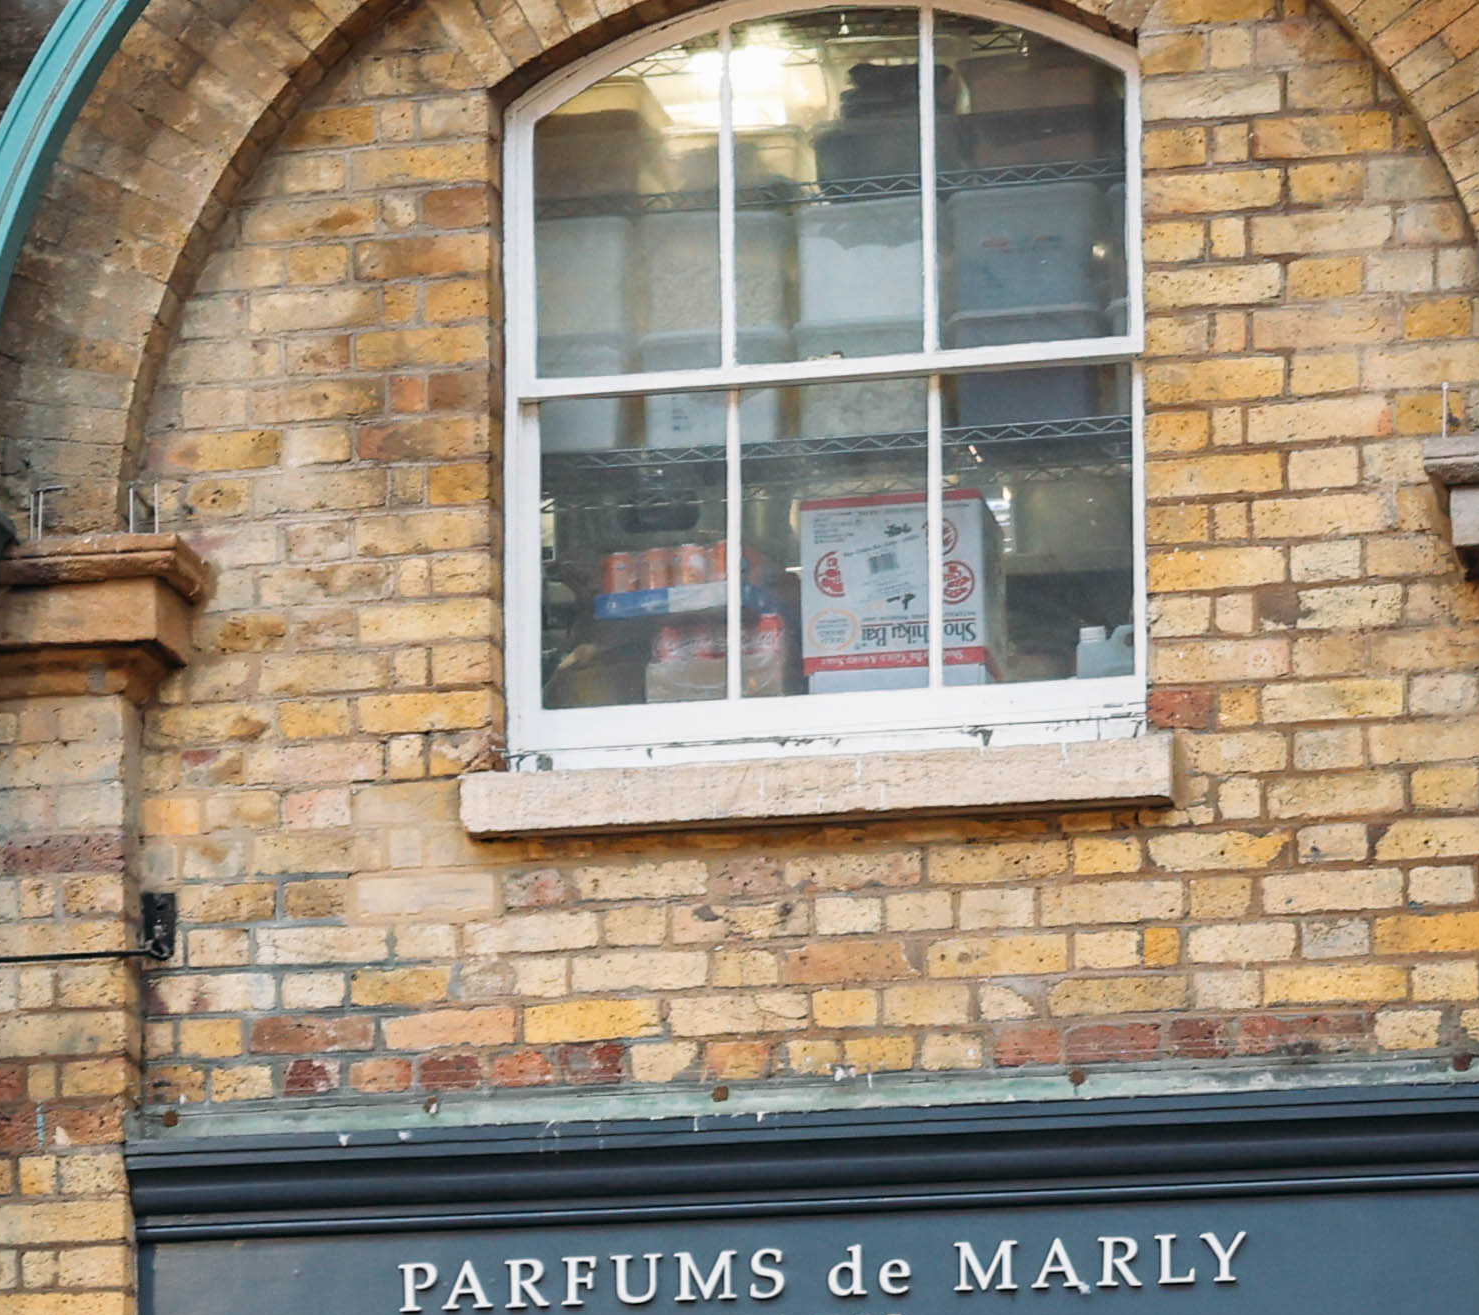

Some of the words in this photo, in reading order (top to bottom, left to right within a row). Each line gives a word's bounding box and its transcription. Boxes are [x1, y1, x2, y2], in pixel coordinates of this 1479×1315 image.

[397, 1246, 787, 1313] PARFUMS
[827, 1243, 911, 1296] de
[953, 1230, 1247, 1294] MARLY
